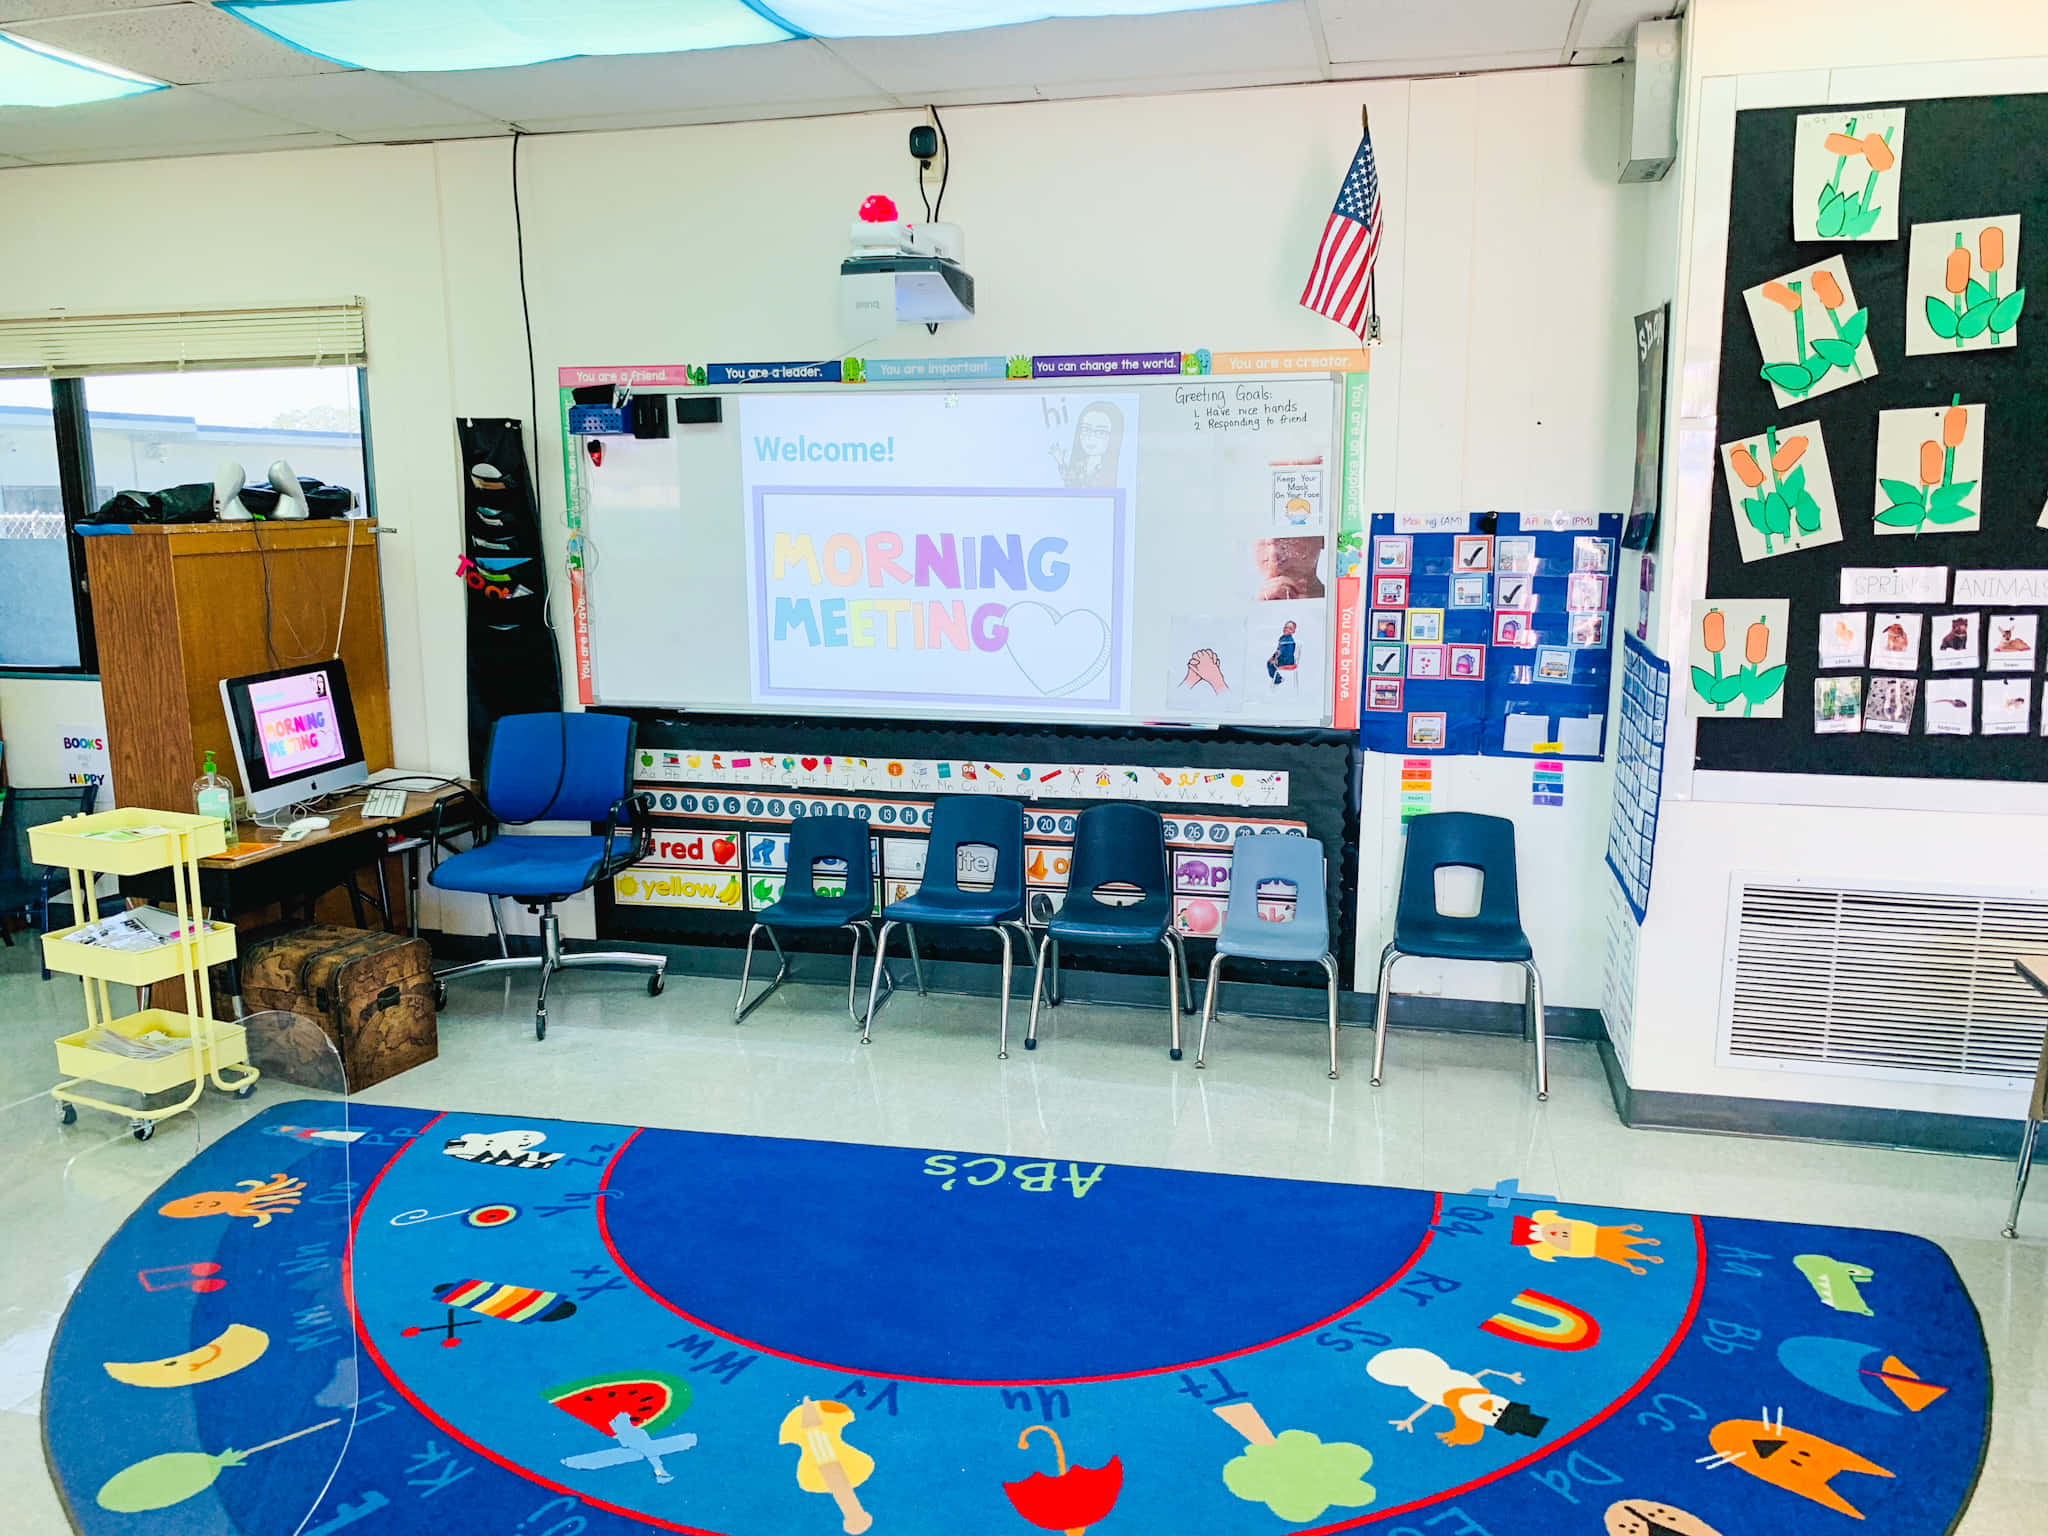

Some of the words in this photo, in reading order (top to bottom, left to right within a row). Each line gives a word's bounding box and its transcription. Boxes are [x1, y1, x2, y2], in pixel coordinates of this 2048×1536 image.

[725, 367, 745, 380] You
[748, 368, 769, 379] are
[771, 369, 780, 379] a
[782, 366, 824, 378] leader.
[880, 363, 900, 376] You
[903, 364, 924, 375] are
[928, 360, 991, 377] important.
[1036, 361, 1056, 374] You
[1058, 362, 1076, 372] can
[1080, 359, 1118, 373] change
[1121, 358, 1139, 371] the
[1141, 357, 1177, 370] world.
[1229, 357, 1250, 370] You
[1255, 359, 1278, 369] are
[1282, 359, 1291, 368] a
[1295, 355, 1353, 368] creator.
[576, 371, 595, 384] You
[598, 372, 617, 383] are
[620, 373, 628, 383] a
[1175, 386, 1226, 408] Greeting
[1236, 384, 1273, 401] Goals:
[1206, 407, 1230, 417] Have
[1238, 406, 1259, 416] nice
[1264, 399, 1298, 414] hands
[1351, 384, 1365, 409] You
[1041, 396, 1068, 429] hi
[1208, 416, 1260, 431] Responding
[1266, 417, 1274, 425] to
[1280, 412, 1307, 424] friend
[1351, 412, 1361, 435] are
[753, 434, 895, 463] Welcome!
[1350, 441, 1360, 457] an
[1440, 517, 1463, 528] (AM)
[772, 531, 1071, 592] MORNING
[773, 596, 1009, 653] MEETING
[1342, 607, 1354, 628] You
[580, 637, 589, 657] are
[1341, 632, 1352, 655] are
[581, 660, 591, 680] You
[1339, 658, 1353, 702] brave.
[264, 711, 326, 740] MORNING
[63, 736, 104, 751] BOOKS
[69, 772, 105, 786] HAPPY
[665, 796, 673, 808] 3
[686, 797, 694, 809] 4
[707, 799, 715, 811] 5
[728, 800, 736, 812] 6
[751, 801, 760, 812] 7
[773, 802, 780, 813] 8
[795, 804, 802, 816] 9
[814, 805, 824, 818] 10
[858, 807, 867, 820] 12
[883, 809, 892, 821] 13
[905, 810, 914, 822] 14
[1040, 818, 1053, 831] 20
[1063, 818, 1073, 831] 21
[1163, 824, 1175, 837] 25
[1188, 826, 1201, 839] 26
[1213, 827, 1225, 840] 27
[660, 837, 703, 860] red
[642, 875, 717, 900] yellow
[360, 1126, 424, 1147] Pp
[565, 1142, 617, 1168] Zz
[923, 1154, 1106, 1199] ABC's
[533, 1188, 625, 1219] Yy
[1426, 1205, 1495, 1238] Qq
[1714, 1243, 1776, 1278] Aa
[569, 1264, 628, 1301] Xx
[1398, 1270, 1463, 1307] Rr
[1315, 1320, 1393, 1352] Ss
[1701, 1318, 1763, 1355] Bb
[666, 1333, 759, 1385] Ww
[834, 1379, 898, 1417] Vv
[1177, 1368, 1249, 1406] Tt
[1637, 1392, 1708, 1432] Cc
[403, 1439, 477, 1499] Kk
[1528, 1450, 1625, 1505] Dd
